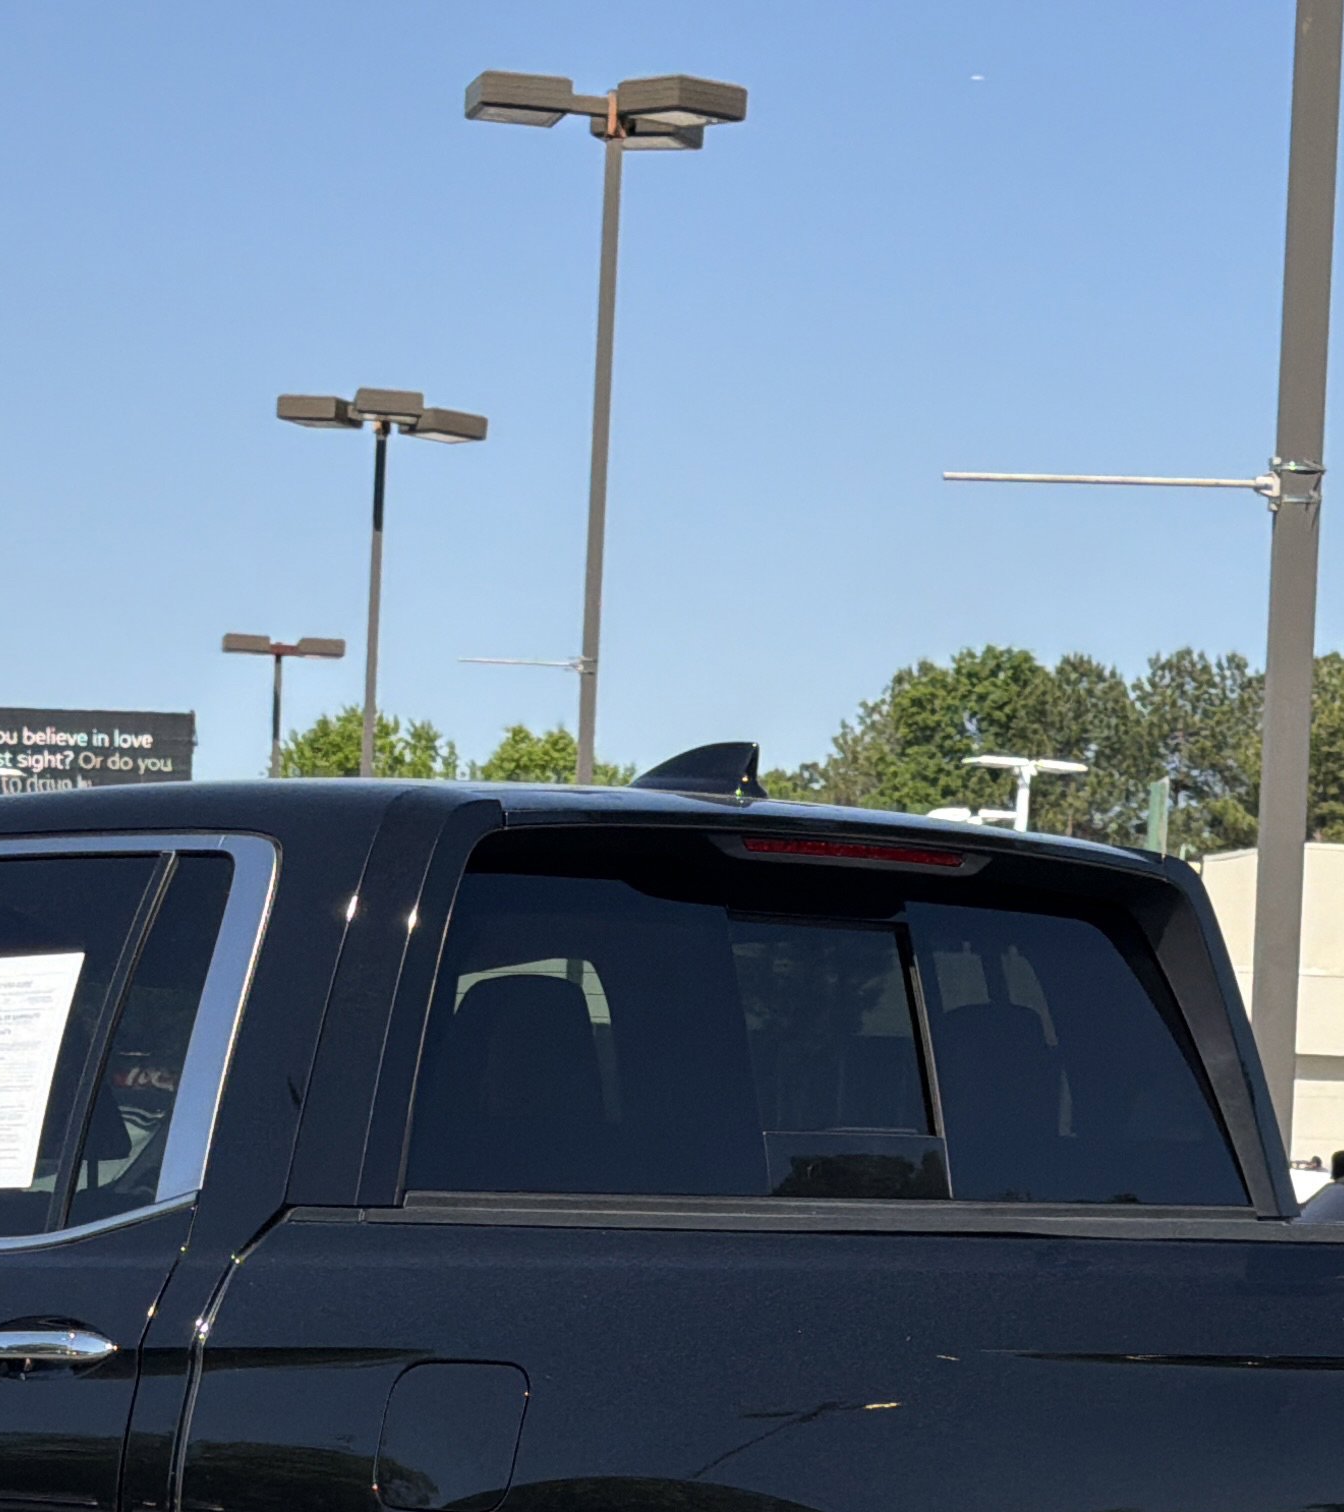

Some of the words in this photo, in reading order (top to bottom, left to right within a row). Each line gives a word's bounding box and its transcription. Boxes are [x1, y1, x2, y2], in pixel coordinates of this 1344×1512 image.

[22, 725, 88, 747] believe
[92, 728, 110, 747] in
[114, 728, 153, 748] love
[16, 750, 75, 772] sight?
[78, 751, 104, 769] Or
[107, 752, 133, 770] do
[137, 757, 173, 775] you
